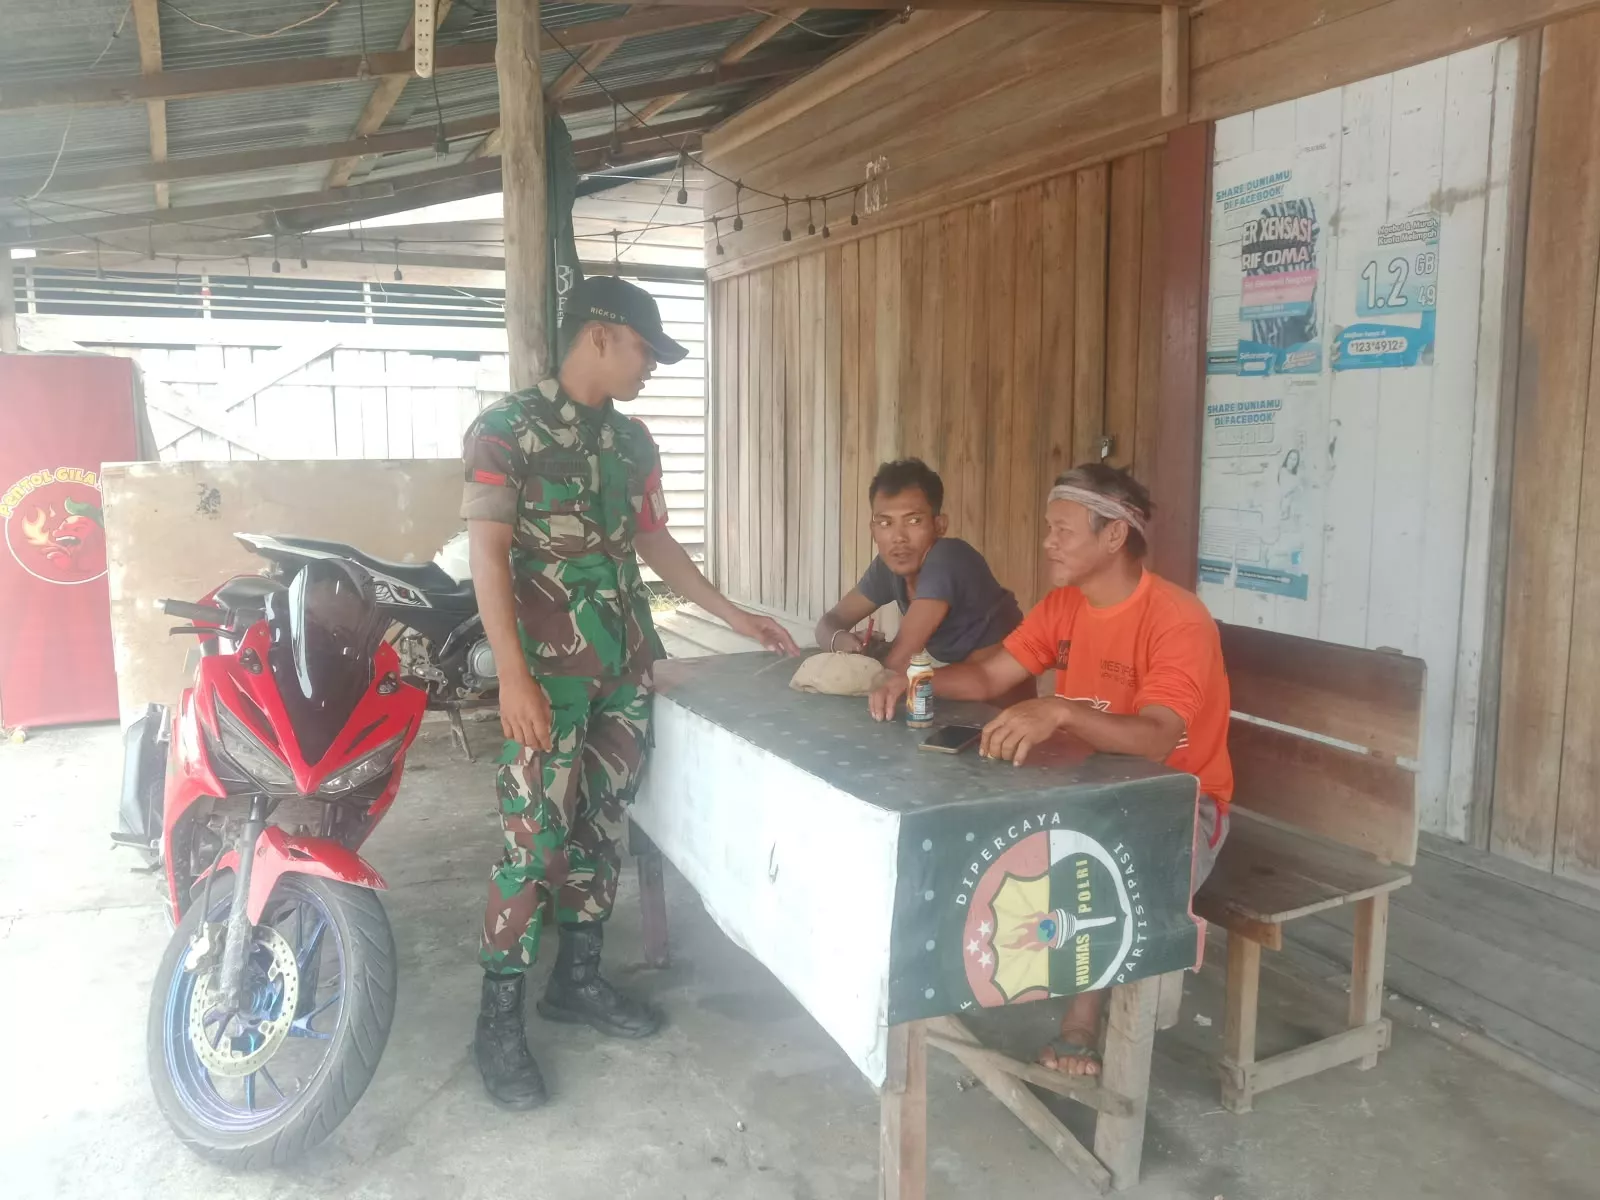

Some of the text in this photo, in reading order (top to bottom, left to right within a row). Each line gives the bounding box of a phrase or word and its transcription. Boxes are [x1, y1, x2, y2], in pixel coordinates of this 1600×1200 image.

[1216, 170, 1291, 200] SHARE DUNIAMU
[1223, 201, 1233, 210] DI
[1260, 216, 1313, 242] XENSASI
[1263, 246, 1309, 267] CDMA
[1361, 252, 1436, 309] 1.2 GB
[1418, 285, 1436, 306] 49
[590, 307, 616, 319] RICKO
[1207, 400, 1281, 414] SHARE DUNIAMU
[1215, 417, 1224, 426] DI
[55, 467, 97, 488] GILA
[956, 812, 1061, 905] DIPERCAYA
[1075, 859, 1092, 986] HUMAS POLRI
[1114, 843, 1147, 983] PARTISIPASI
